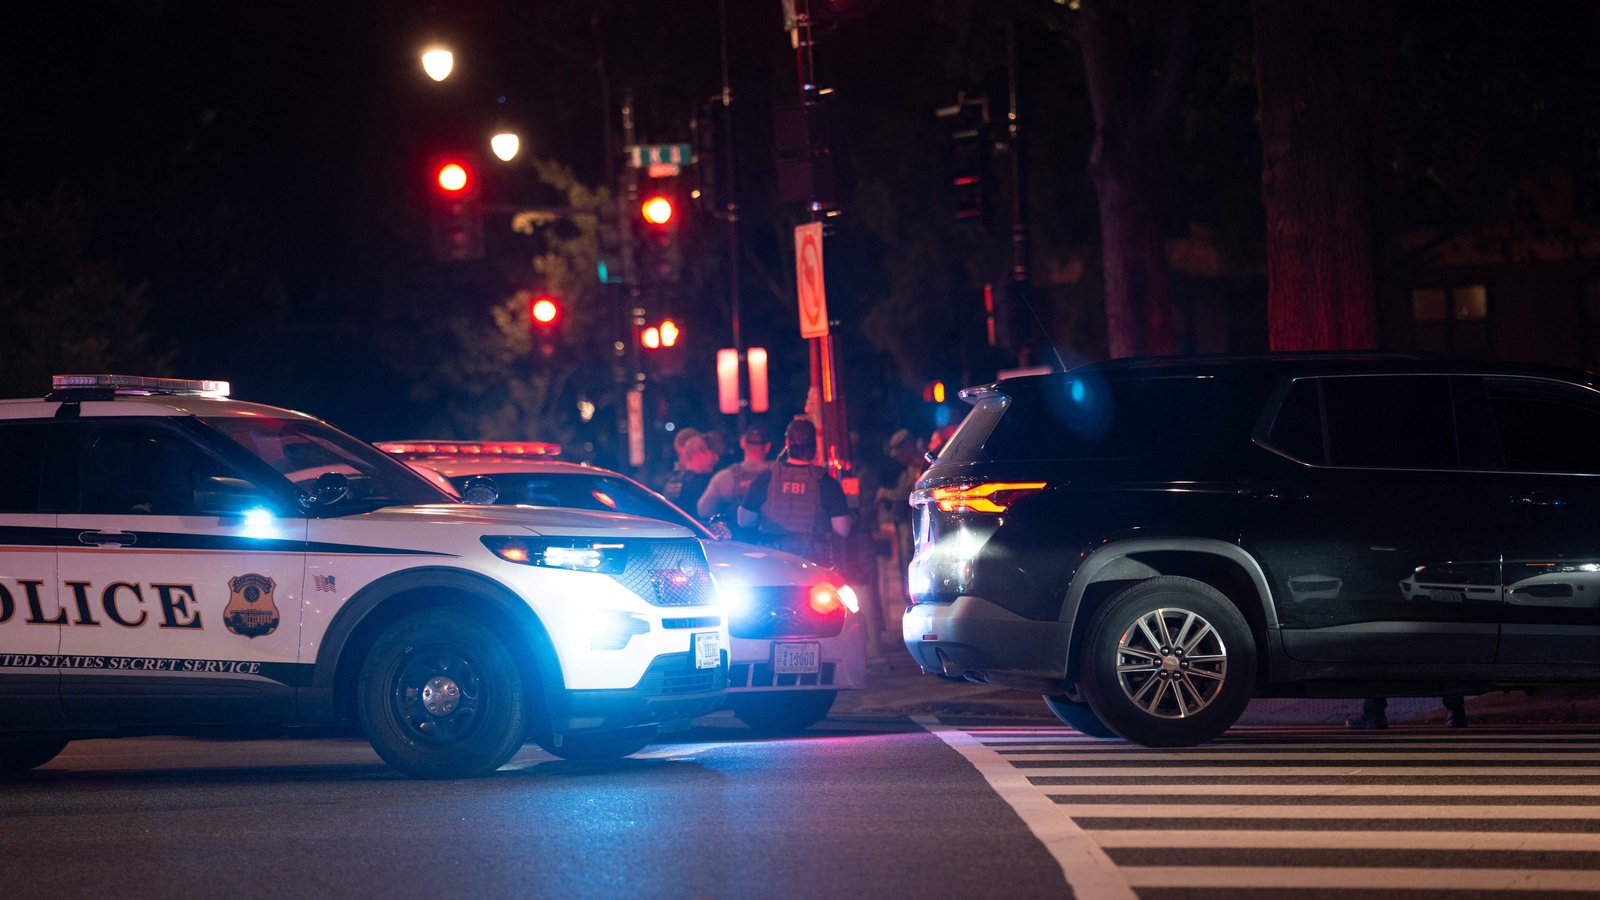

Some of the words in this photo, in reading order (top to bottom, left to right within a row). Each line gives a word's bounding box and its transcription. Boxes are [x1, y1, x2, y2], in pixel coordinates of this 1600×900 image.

[782, 481, 805, 494] FBI
[0, 654, 37, 667] TED
[39, 655, 105, 668] STATES
[108, 657, 180, 671] SECRET
[182, 659, 261, 674] SERVICE
